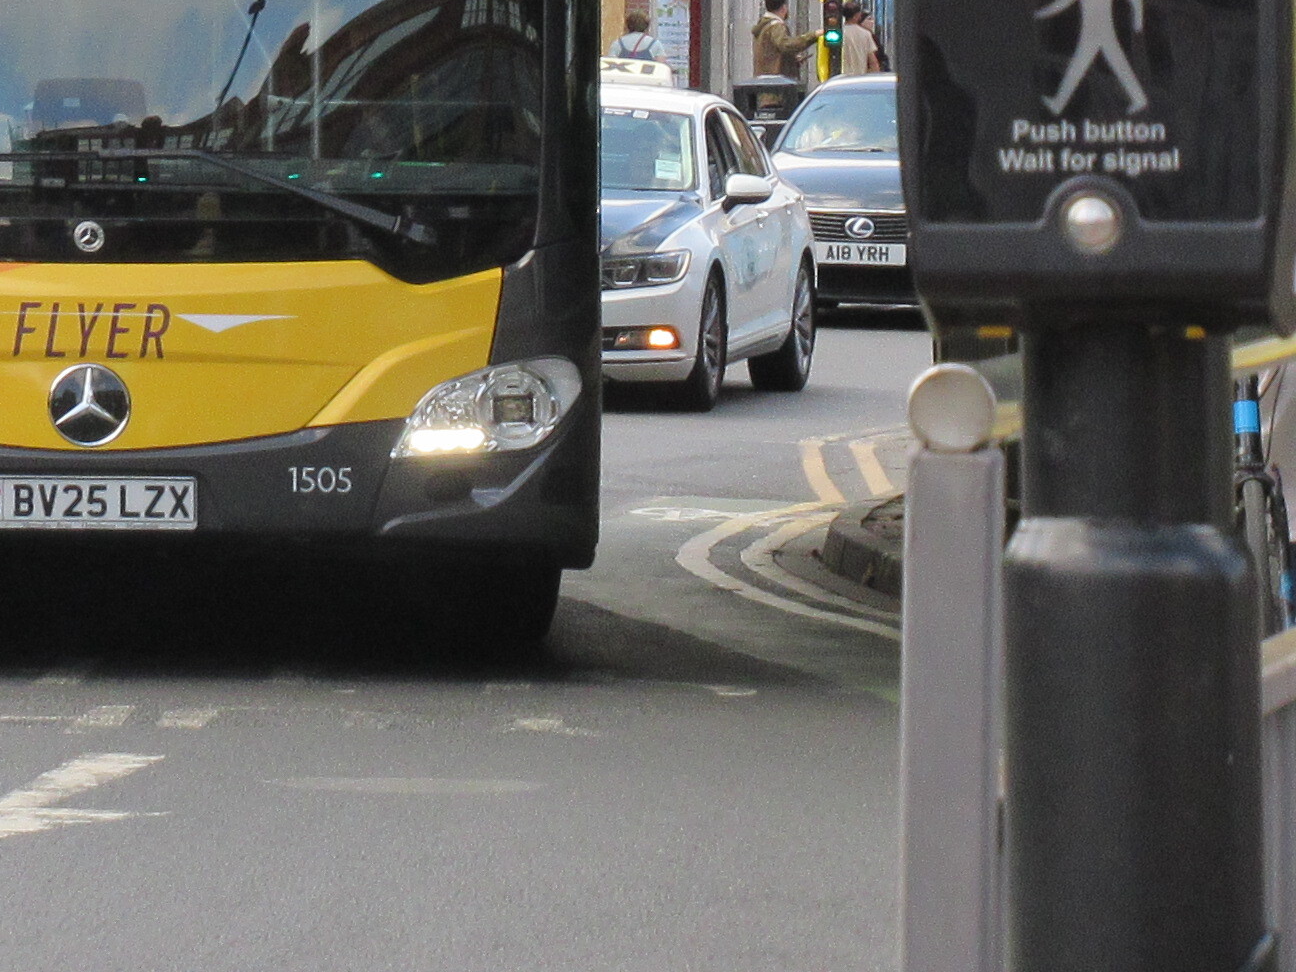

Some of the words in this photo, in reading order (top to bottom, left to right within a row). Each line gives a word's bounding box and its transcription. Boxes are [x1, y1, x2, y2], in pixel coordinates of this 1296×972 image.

[600, 59, 656, 76] XI
[1012, 119, 1077, 143] Push
[1083, 118, 1167, 143] button
[998, 148, 1055, 172] Wait
[1060, 147, 1098, 172] for
[1102, 147, 1181, 177] signal
[826, 244, 852, 261] A18
[857, 245, 889, 262] YRH
[12, 301, 171, 359] FLYER
[288, 466, 353, 494] 1505
[13, 483, 108, 518] BV25
[119, 484, 191, 519] LZX
